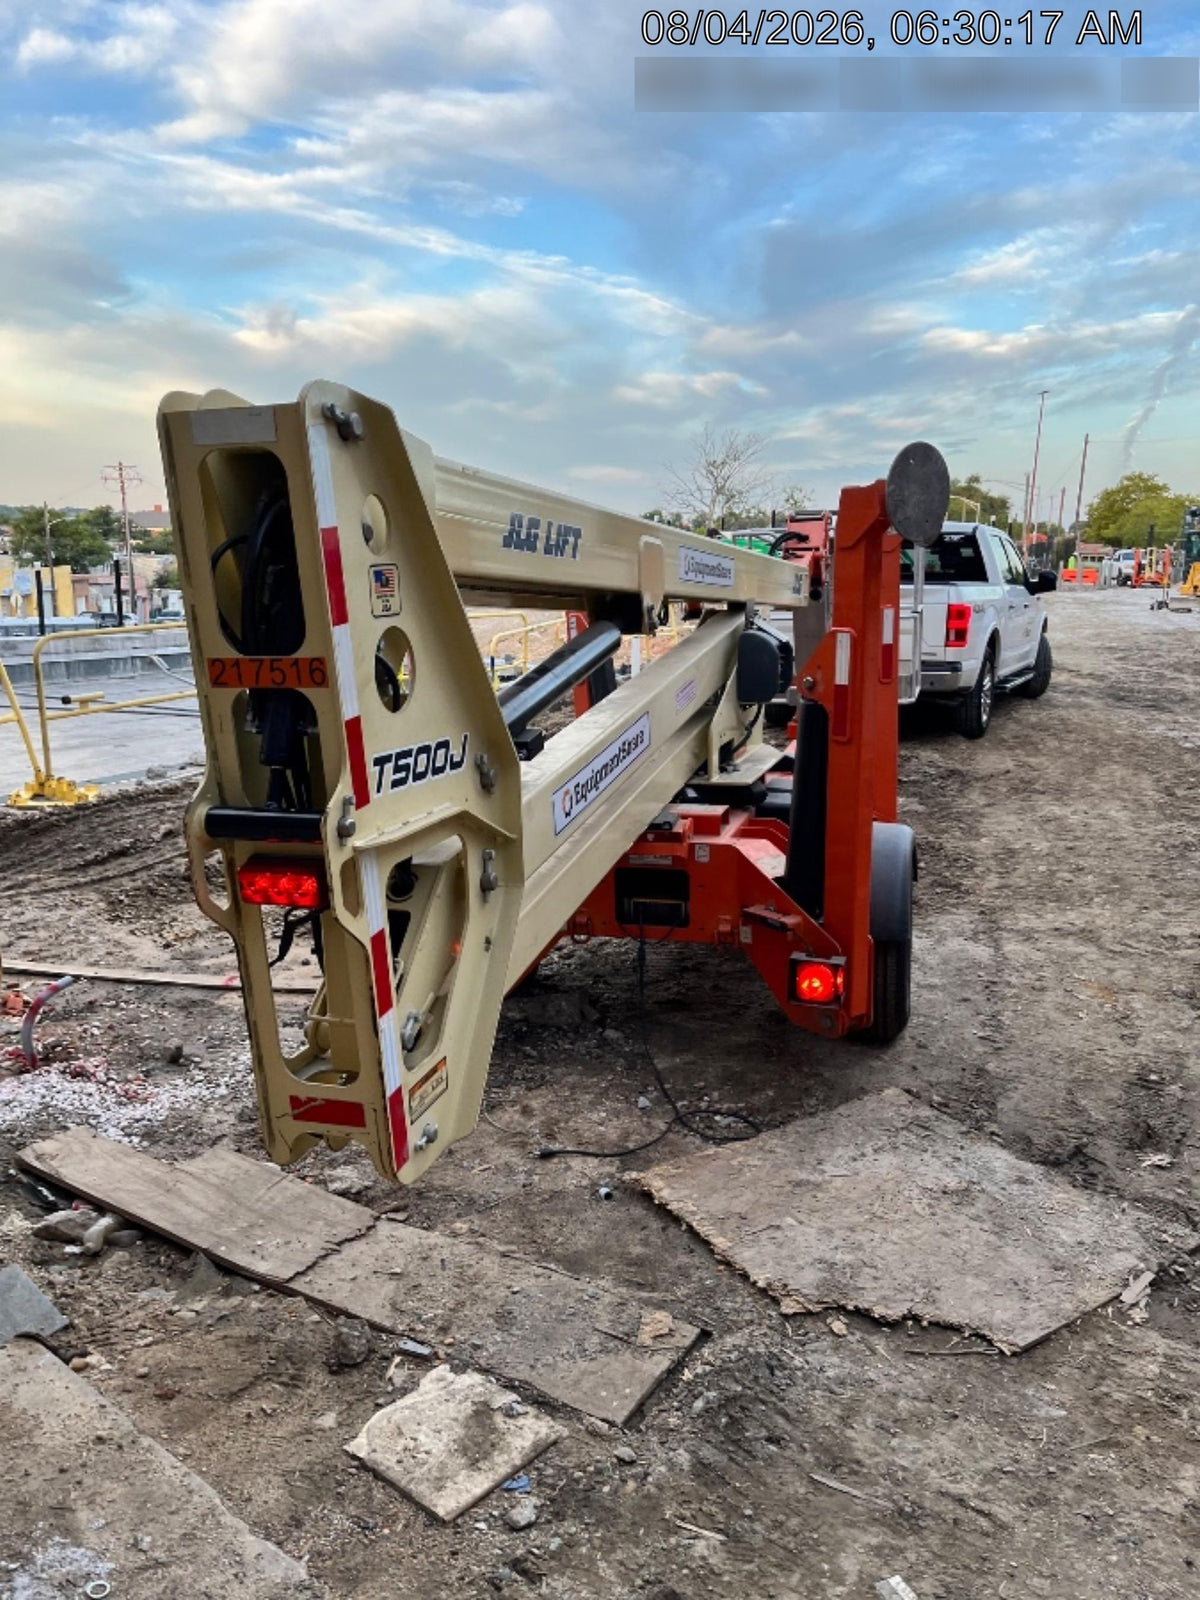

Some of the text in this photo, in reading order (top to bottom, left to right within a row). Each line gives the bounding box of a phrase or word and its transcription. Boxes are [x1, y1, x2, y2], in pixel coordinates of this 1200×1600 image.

[543, 520, 583, 560] LIFT
[210, 658, 326, 686] 217516
[372, 732, 469, 795] T500J
